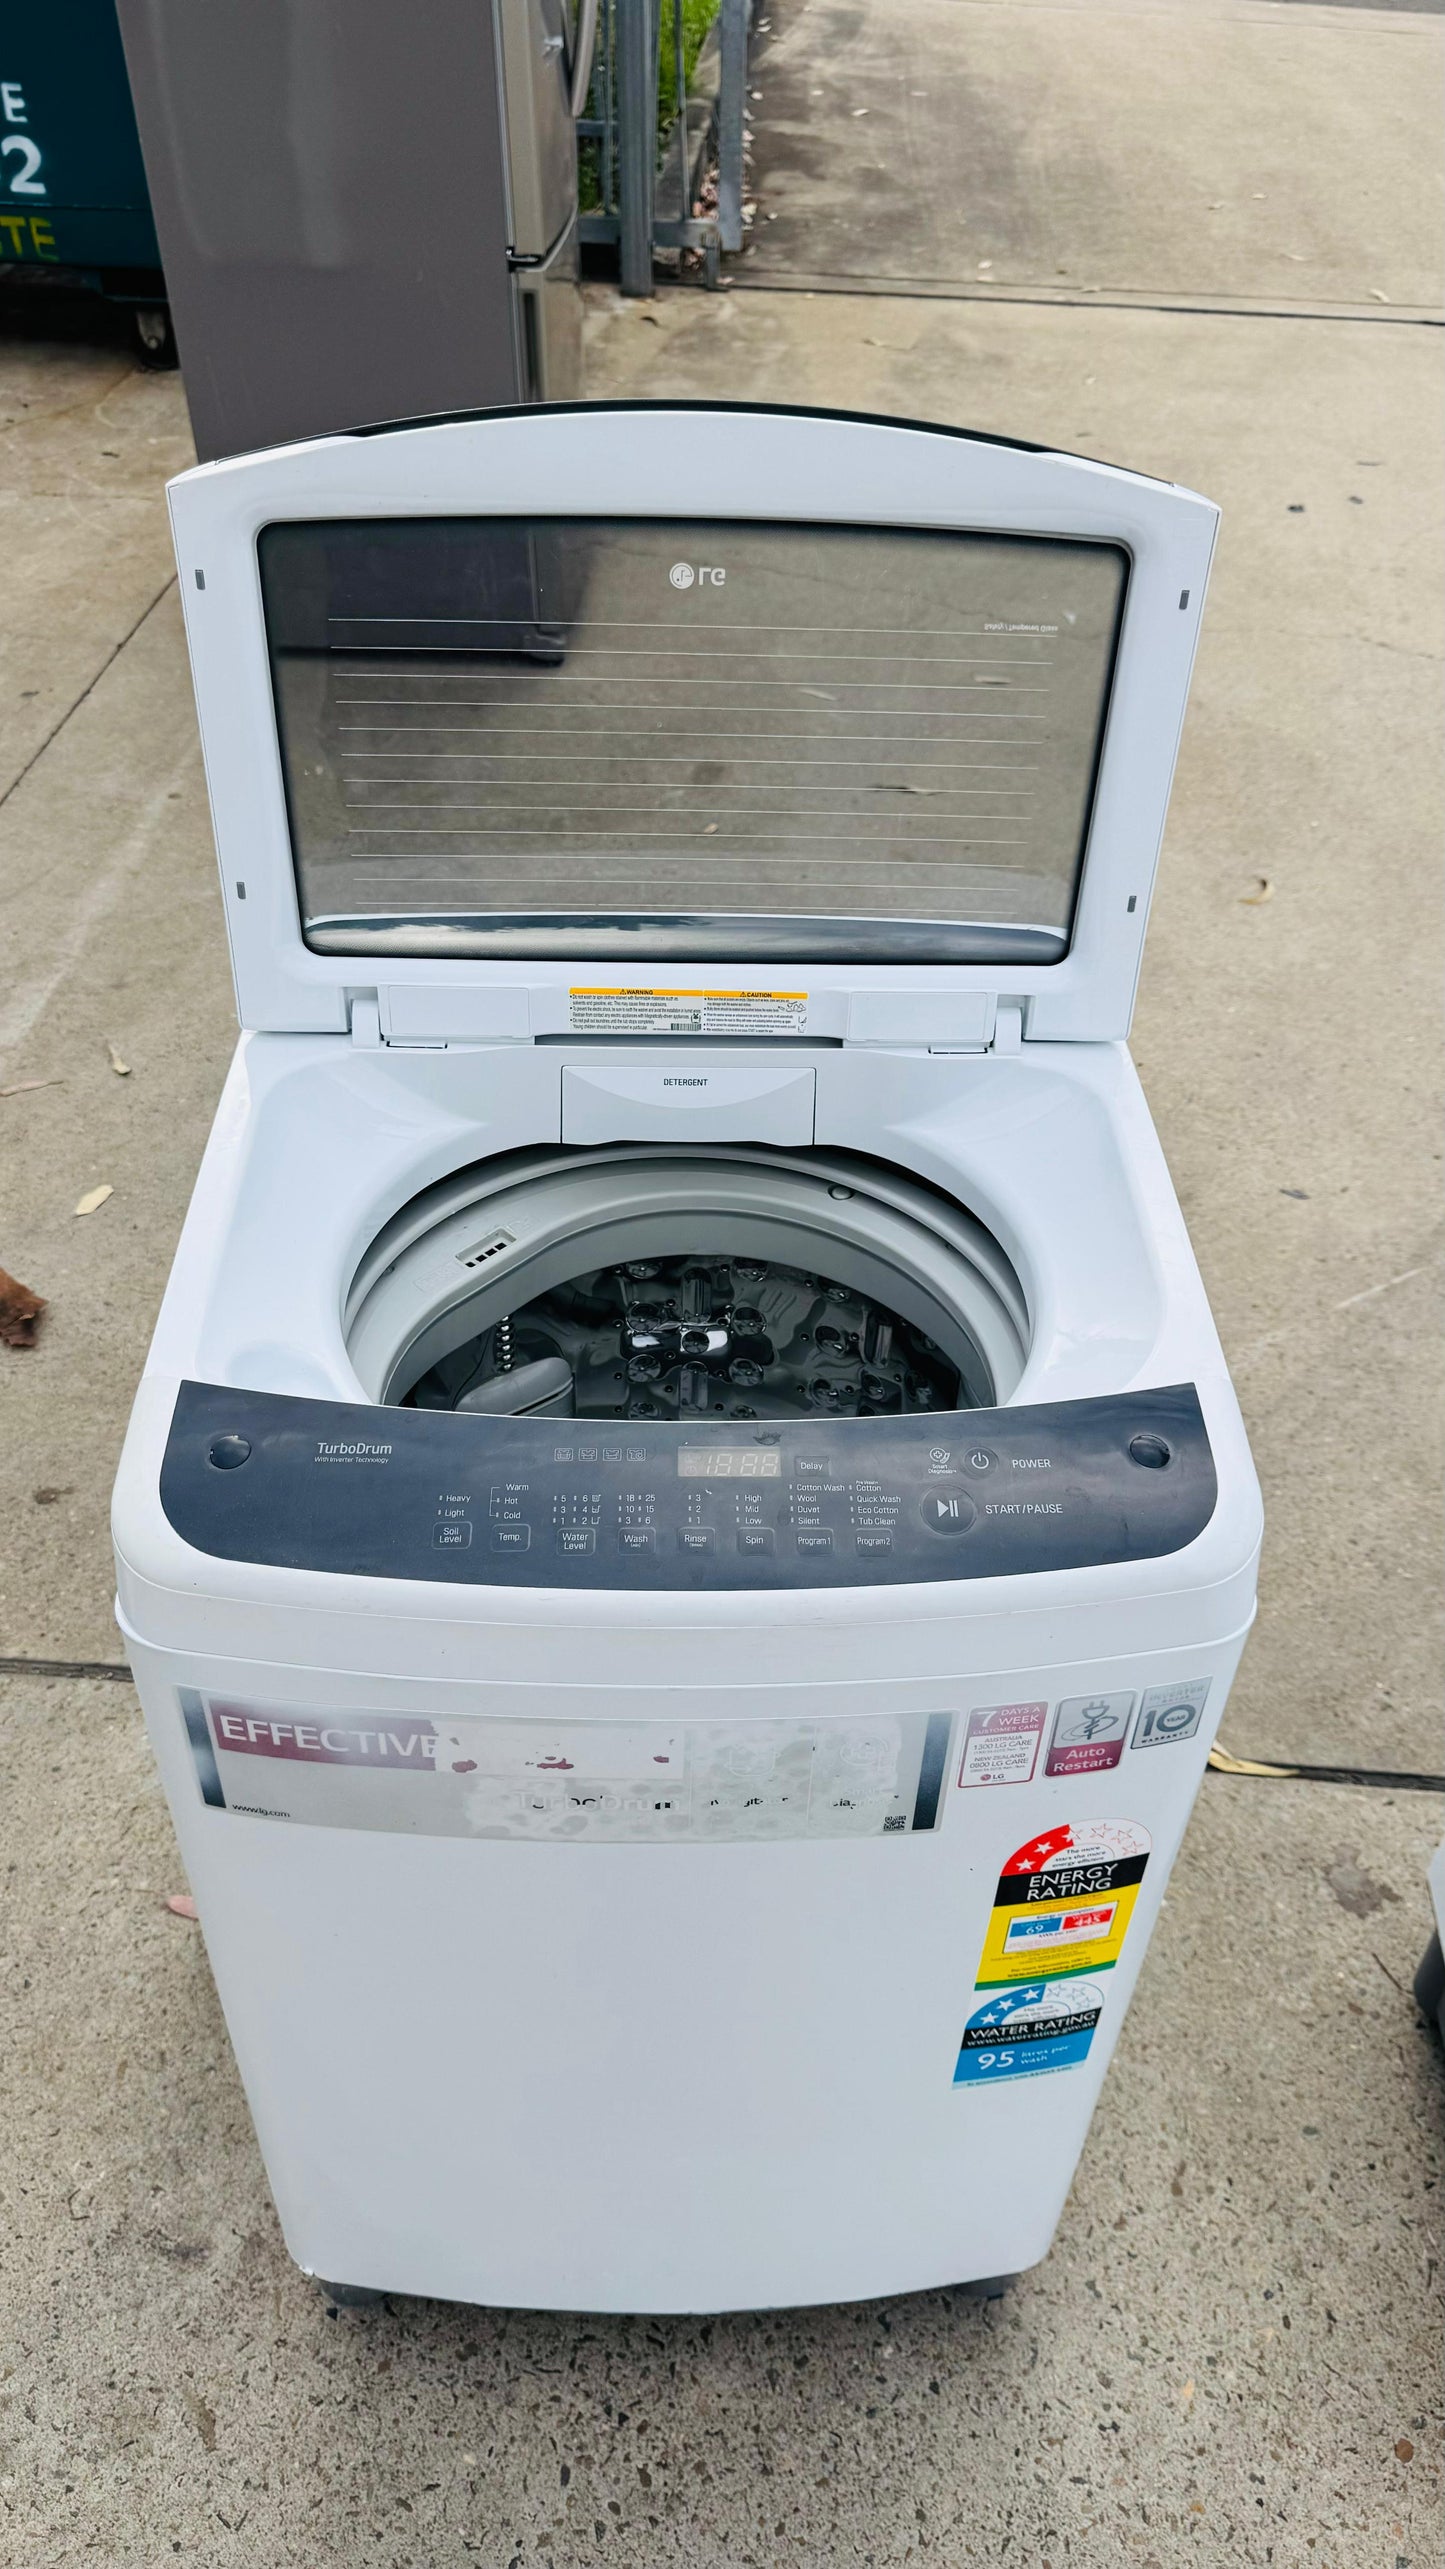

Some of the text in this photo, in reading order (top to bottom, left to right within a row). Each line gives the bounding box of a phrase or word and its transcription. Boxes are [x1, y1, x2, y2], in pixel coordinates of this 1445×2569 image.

[0, 215, 59, 261] TE
[663, 1078, 709, 1086] DETERGENT
[317, 1442, 392, 1454] TurboDrum
[800, 1462, 823, 1471] Delay
[1012, 1459, 1051, 1469] POWER
[446, 1495, 471, 1503] Heavy
[744, 1494, 761, 1502] High
[445, 1509, 465, 1518] Light
[985, 1504, 1063, 1514] START/PAUSE
[443, 1527, 459, 1535] Soil
[439, 1535, 462, 1543] Level
[499, 1532, 522, 1542] Temp.
[562, 1533, 588, 1541] Water
[624, 1534, 648, 1543] Wash
[684, 1534, 707, 1543] Rinse
[745, 1535, 764, 1545] Spin
[564, 1542, 587, 1550] Level
[977, 1710, 998, 1728] 7
[1001, 1707, 1030, 1716] DAYS
[999, 1714, 1040, 1726] WEEK
[973, 1726, 1017, 1735] CUSTOMER
[220, 1714, 439, 1758] EFFECTIVE
[1066, 1748, 1106, 1759] Auto
[1005, 1758, 1029, 1766] CARE
[1053, 1757, 1114, 1772] Restart
[232, 1804, 291, 1817] www.lg.com
[1029, 1863, 1118, 1888] ENERGY
[1027, 1877, 1112, 1901] RATING
[1026, 1924, 1044, 1935] 69
[970, 2024, 1029, 2039] WATER
[1034, 2011, 1097, 2031] RATING
[977, 2050, 1015, 2070] 95
